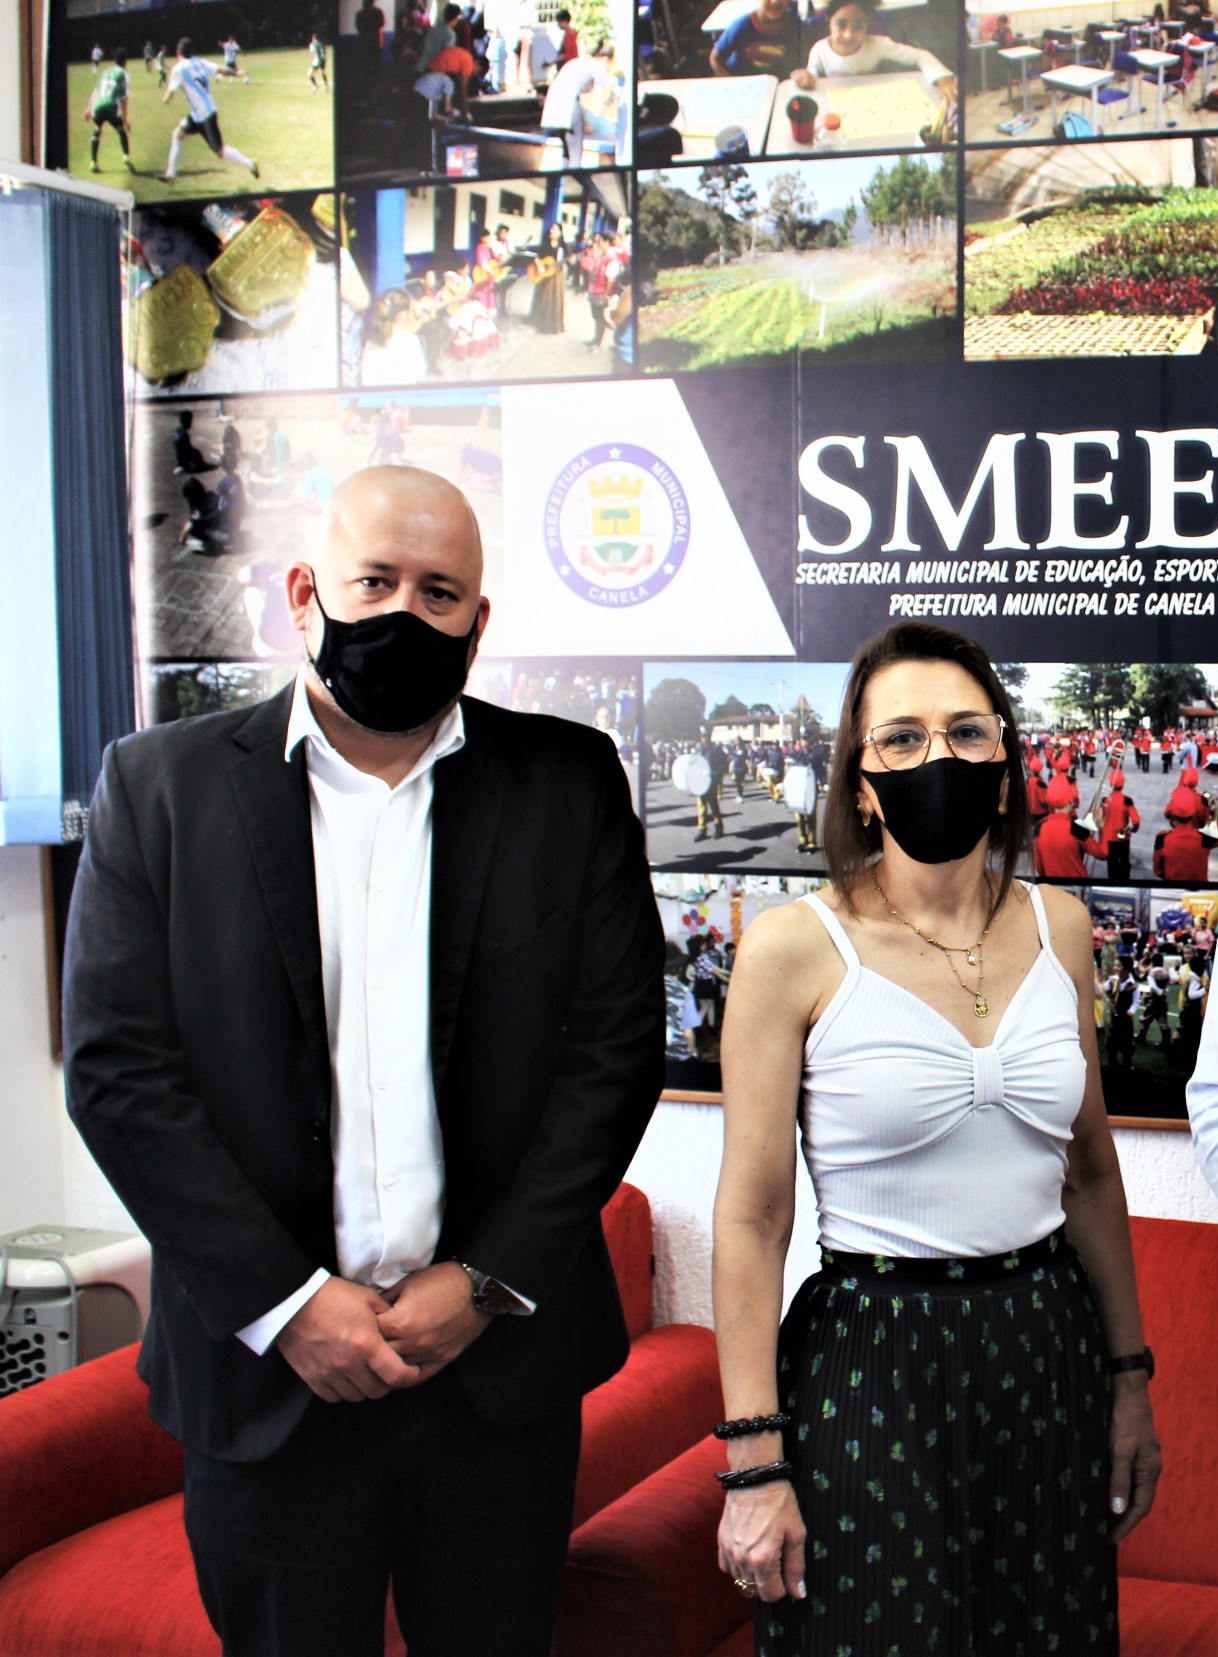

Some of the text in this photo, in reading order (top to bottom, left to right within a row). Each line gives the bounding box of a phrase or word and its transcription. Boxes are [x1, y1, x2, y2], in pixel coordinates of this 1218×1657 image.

[546, 456, 688, 548] PREFEITURA MUNICIPAL
[795, 562, 901, 585] SECRETARIA
[905, 560, 1009, 584] MUNICIPAL
[1014, 559, 1041, 583] DE
[1044, 555, 1146, 588] EDUCAÇÃO,
[587, 586, 650, 604] CANELA
[888, 592, 1216, 617] PREFEITURA MUNICIPAL DE CANELA
